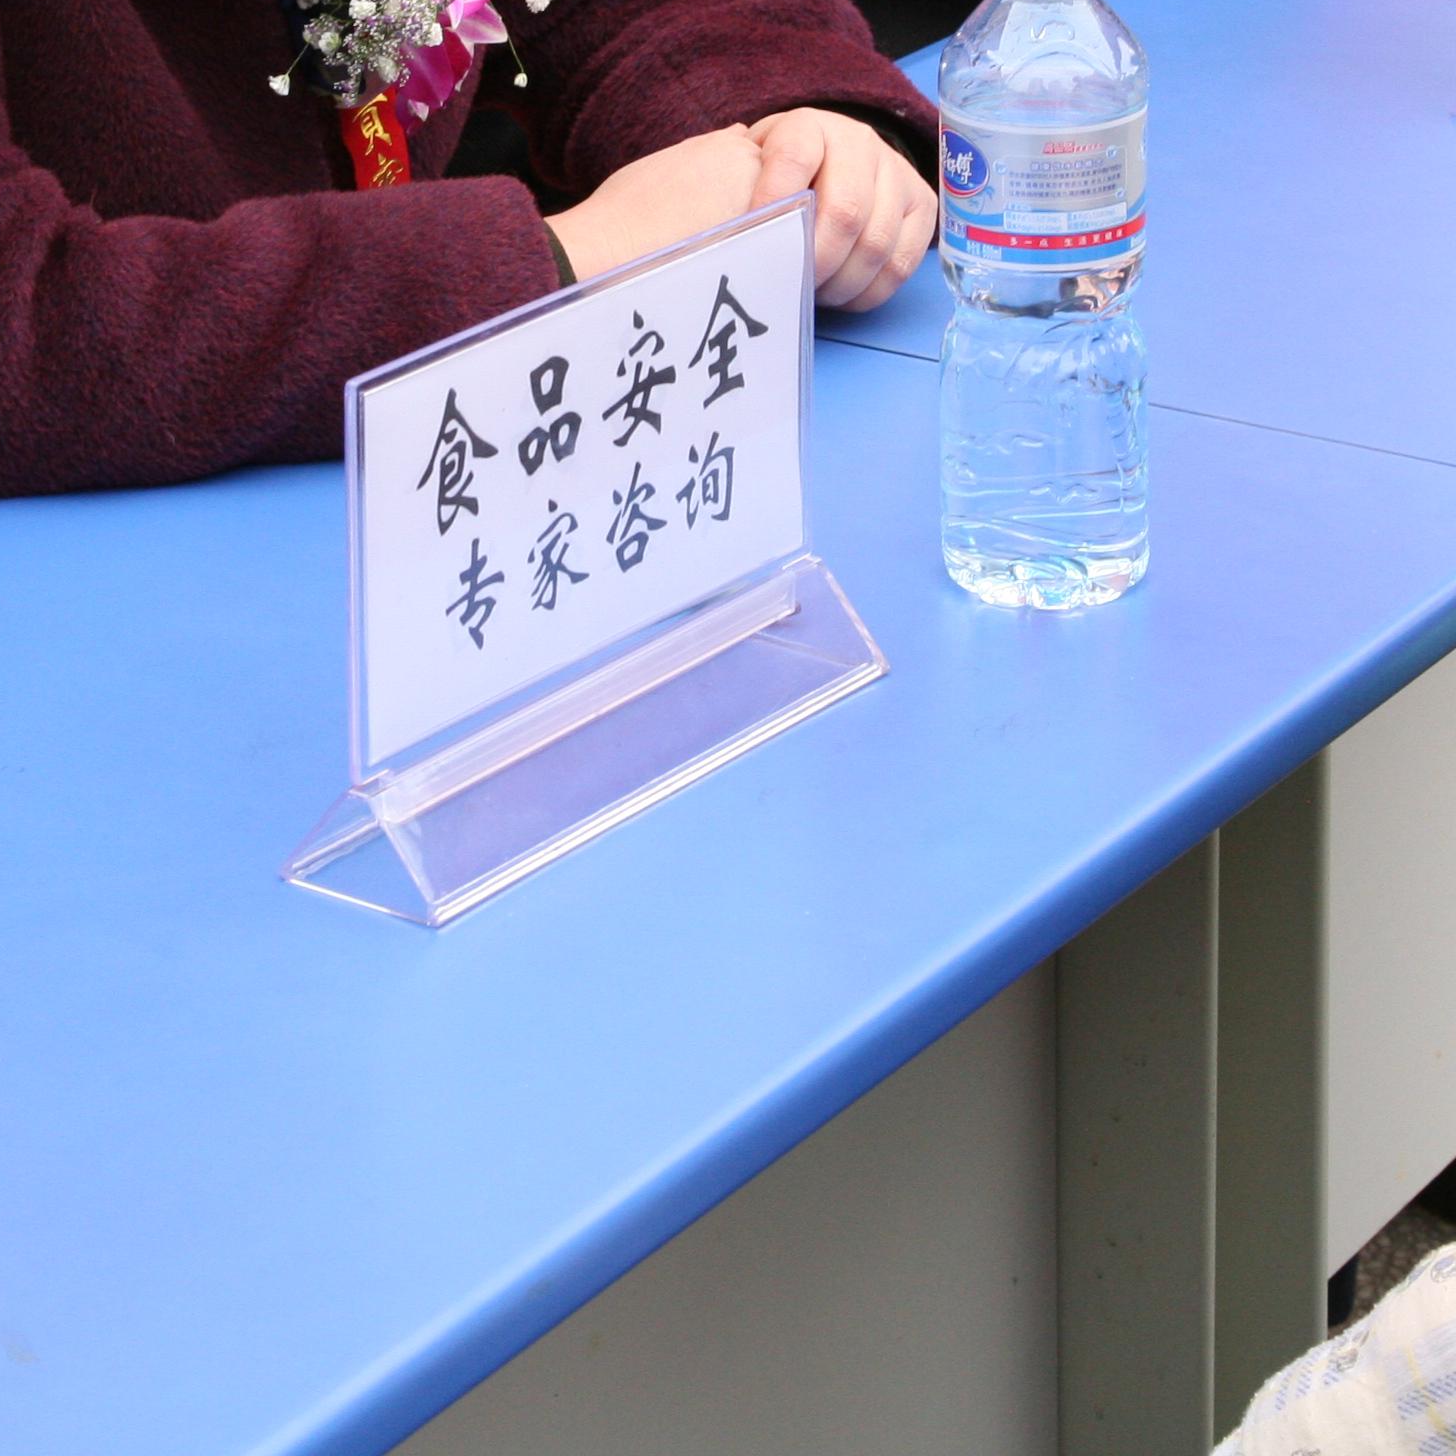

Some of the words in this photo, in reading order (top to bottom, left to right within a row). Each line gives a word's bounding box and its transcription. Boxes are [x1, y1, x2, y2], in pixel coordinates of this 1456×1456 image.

[415, 273, 769, 537] 食品安全
[446, 432, 735, 650] 专家咨询
